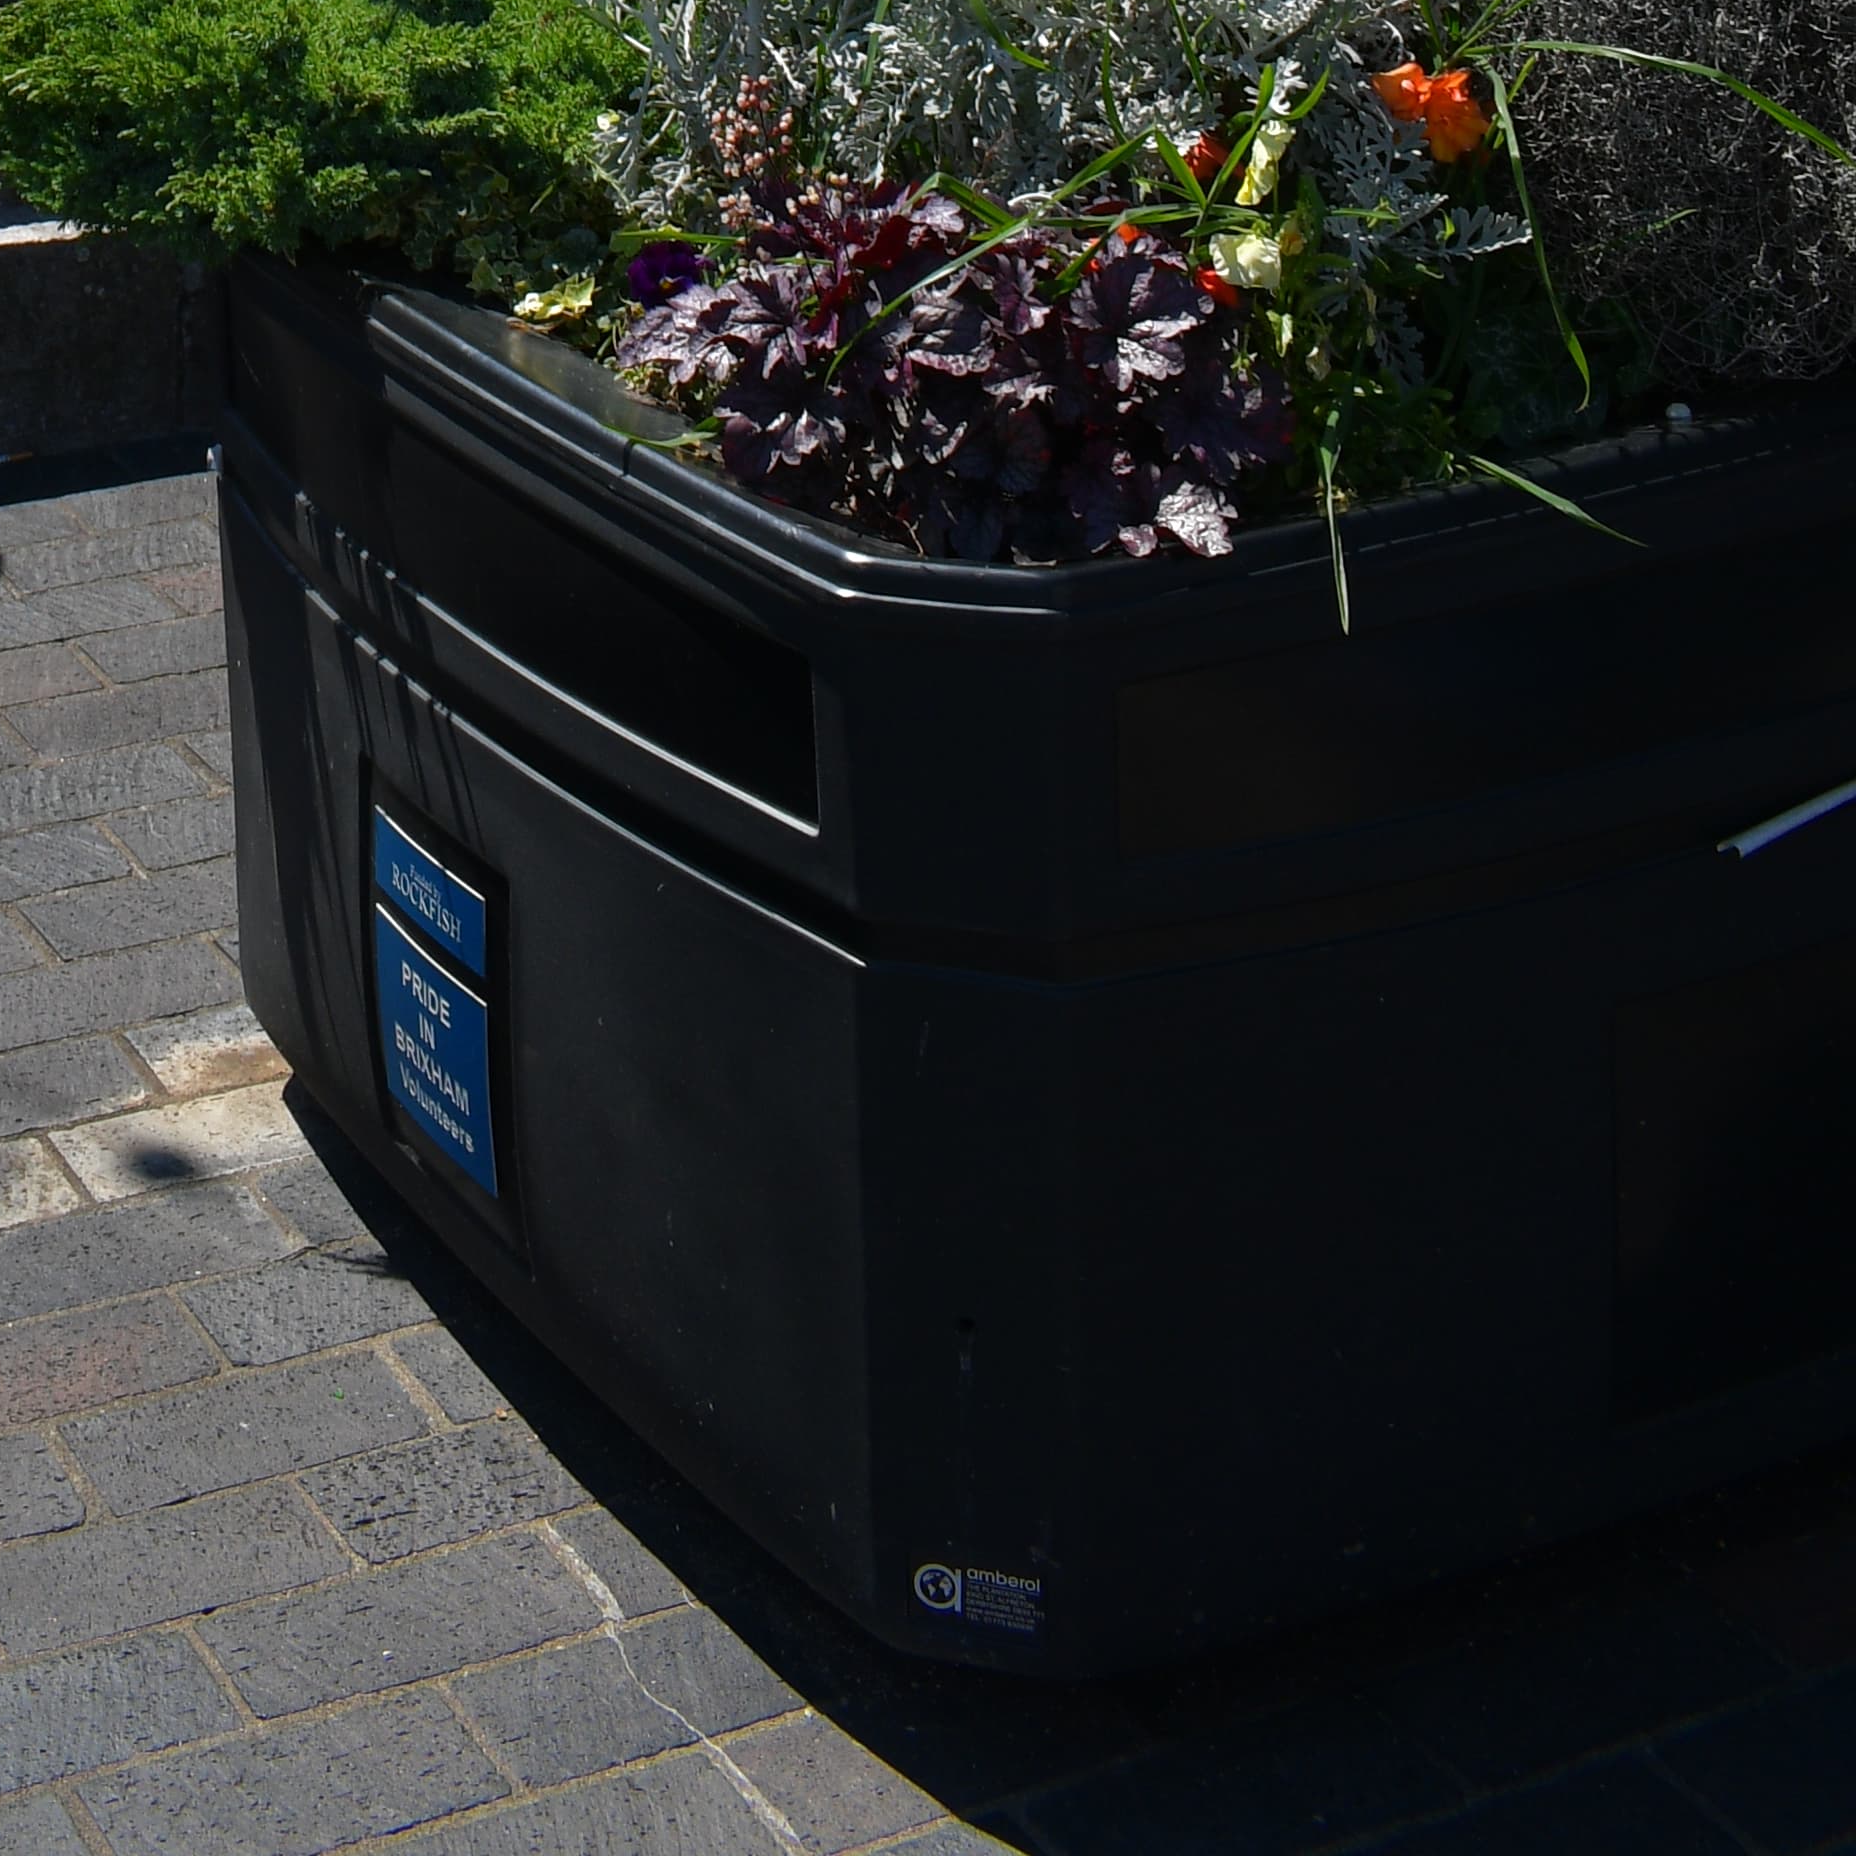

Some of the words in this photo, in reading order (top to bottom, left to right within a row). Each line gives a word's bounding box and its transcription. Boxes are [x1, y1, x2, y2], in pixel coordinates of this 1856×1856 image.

[391, 861, 463, 943] ROCKFISH
[401, 959, 452, 1029] PRIDE
[418, 1011, 436, 1051] IN
[394, 1020, 471, 1117] BRIXHAM
[399, 1060, 475, 1154] Volunteers
[966, 1567, 1041, 1593] amberol
